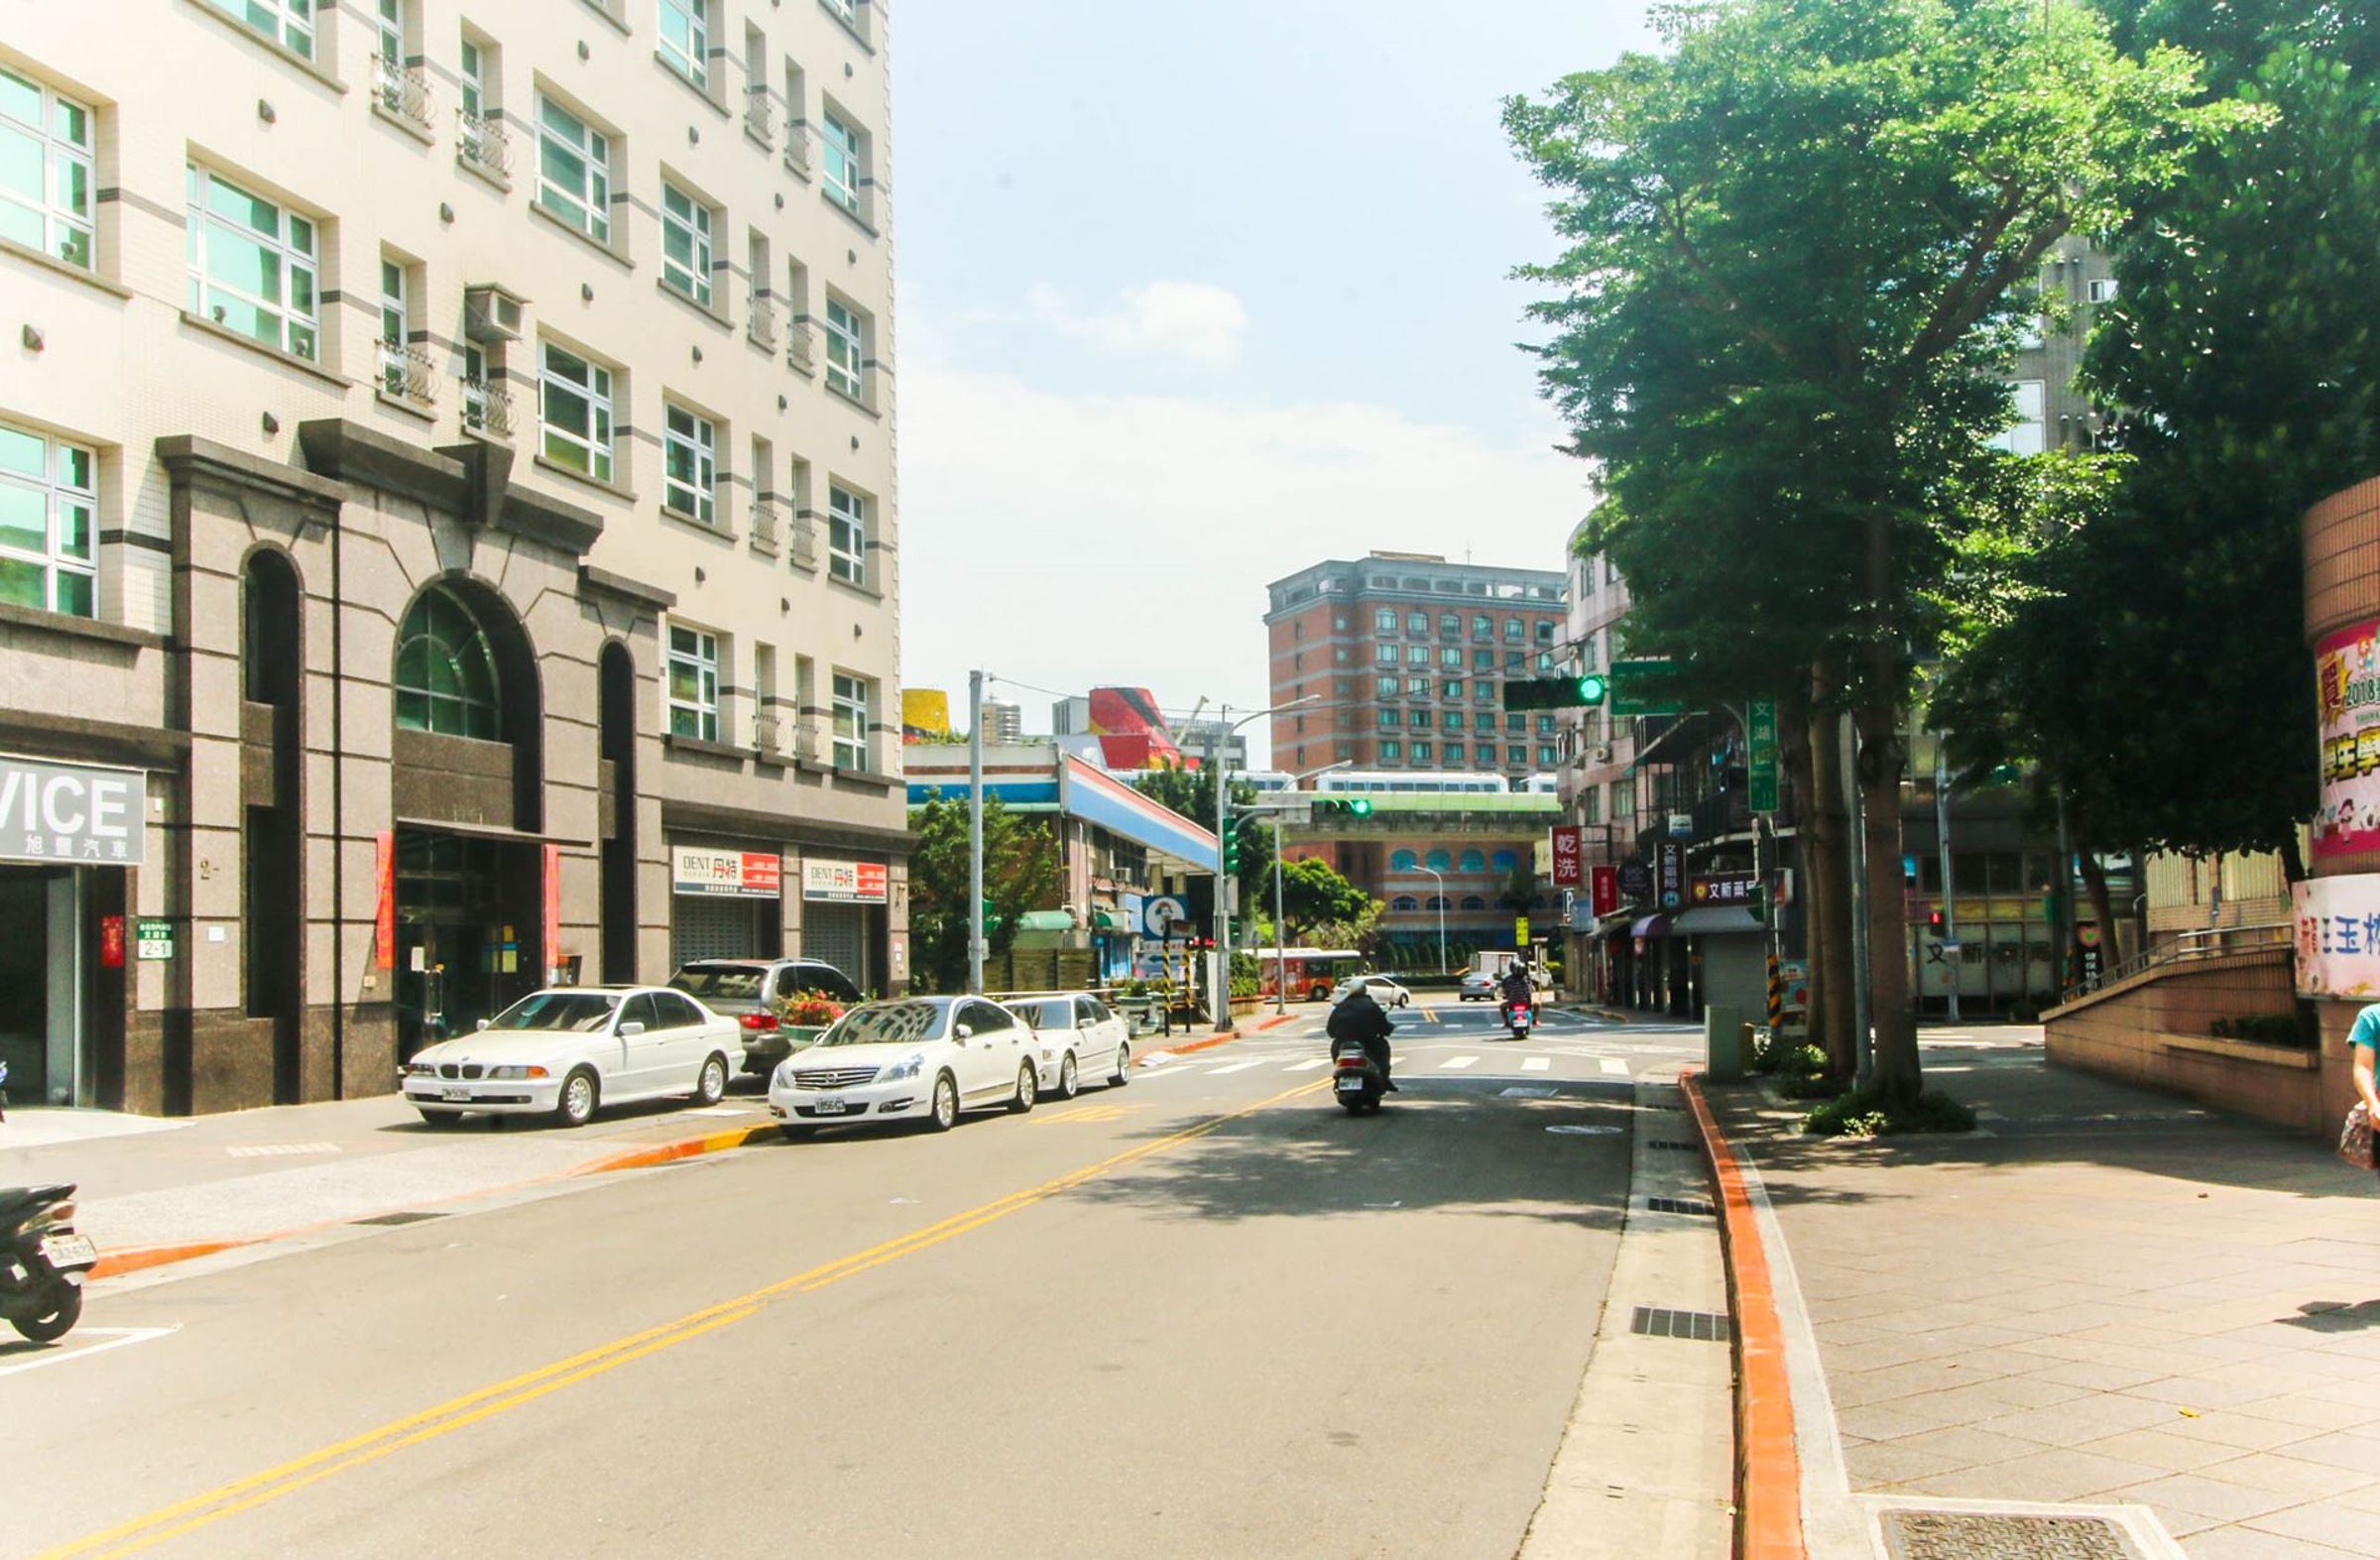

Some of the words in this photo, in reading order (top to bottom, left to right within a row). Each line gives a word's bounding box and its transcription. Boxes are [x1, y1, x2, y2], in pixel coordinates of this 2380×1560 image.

[2345, 677, 2380, 706] 2018
[683, 855, 710, 870] DENT
[1556, 834, 1578, 879] 乾洗
